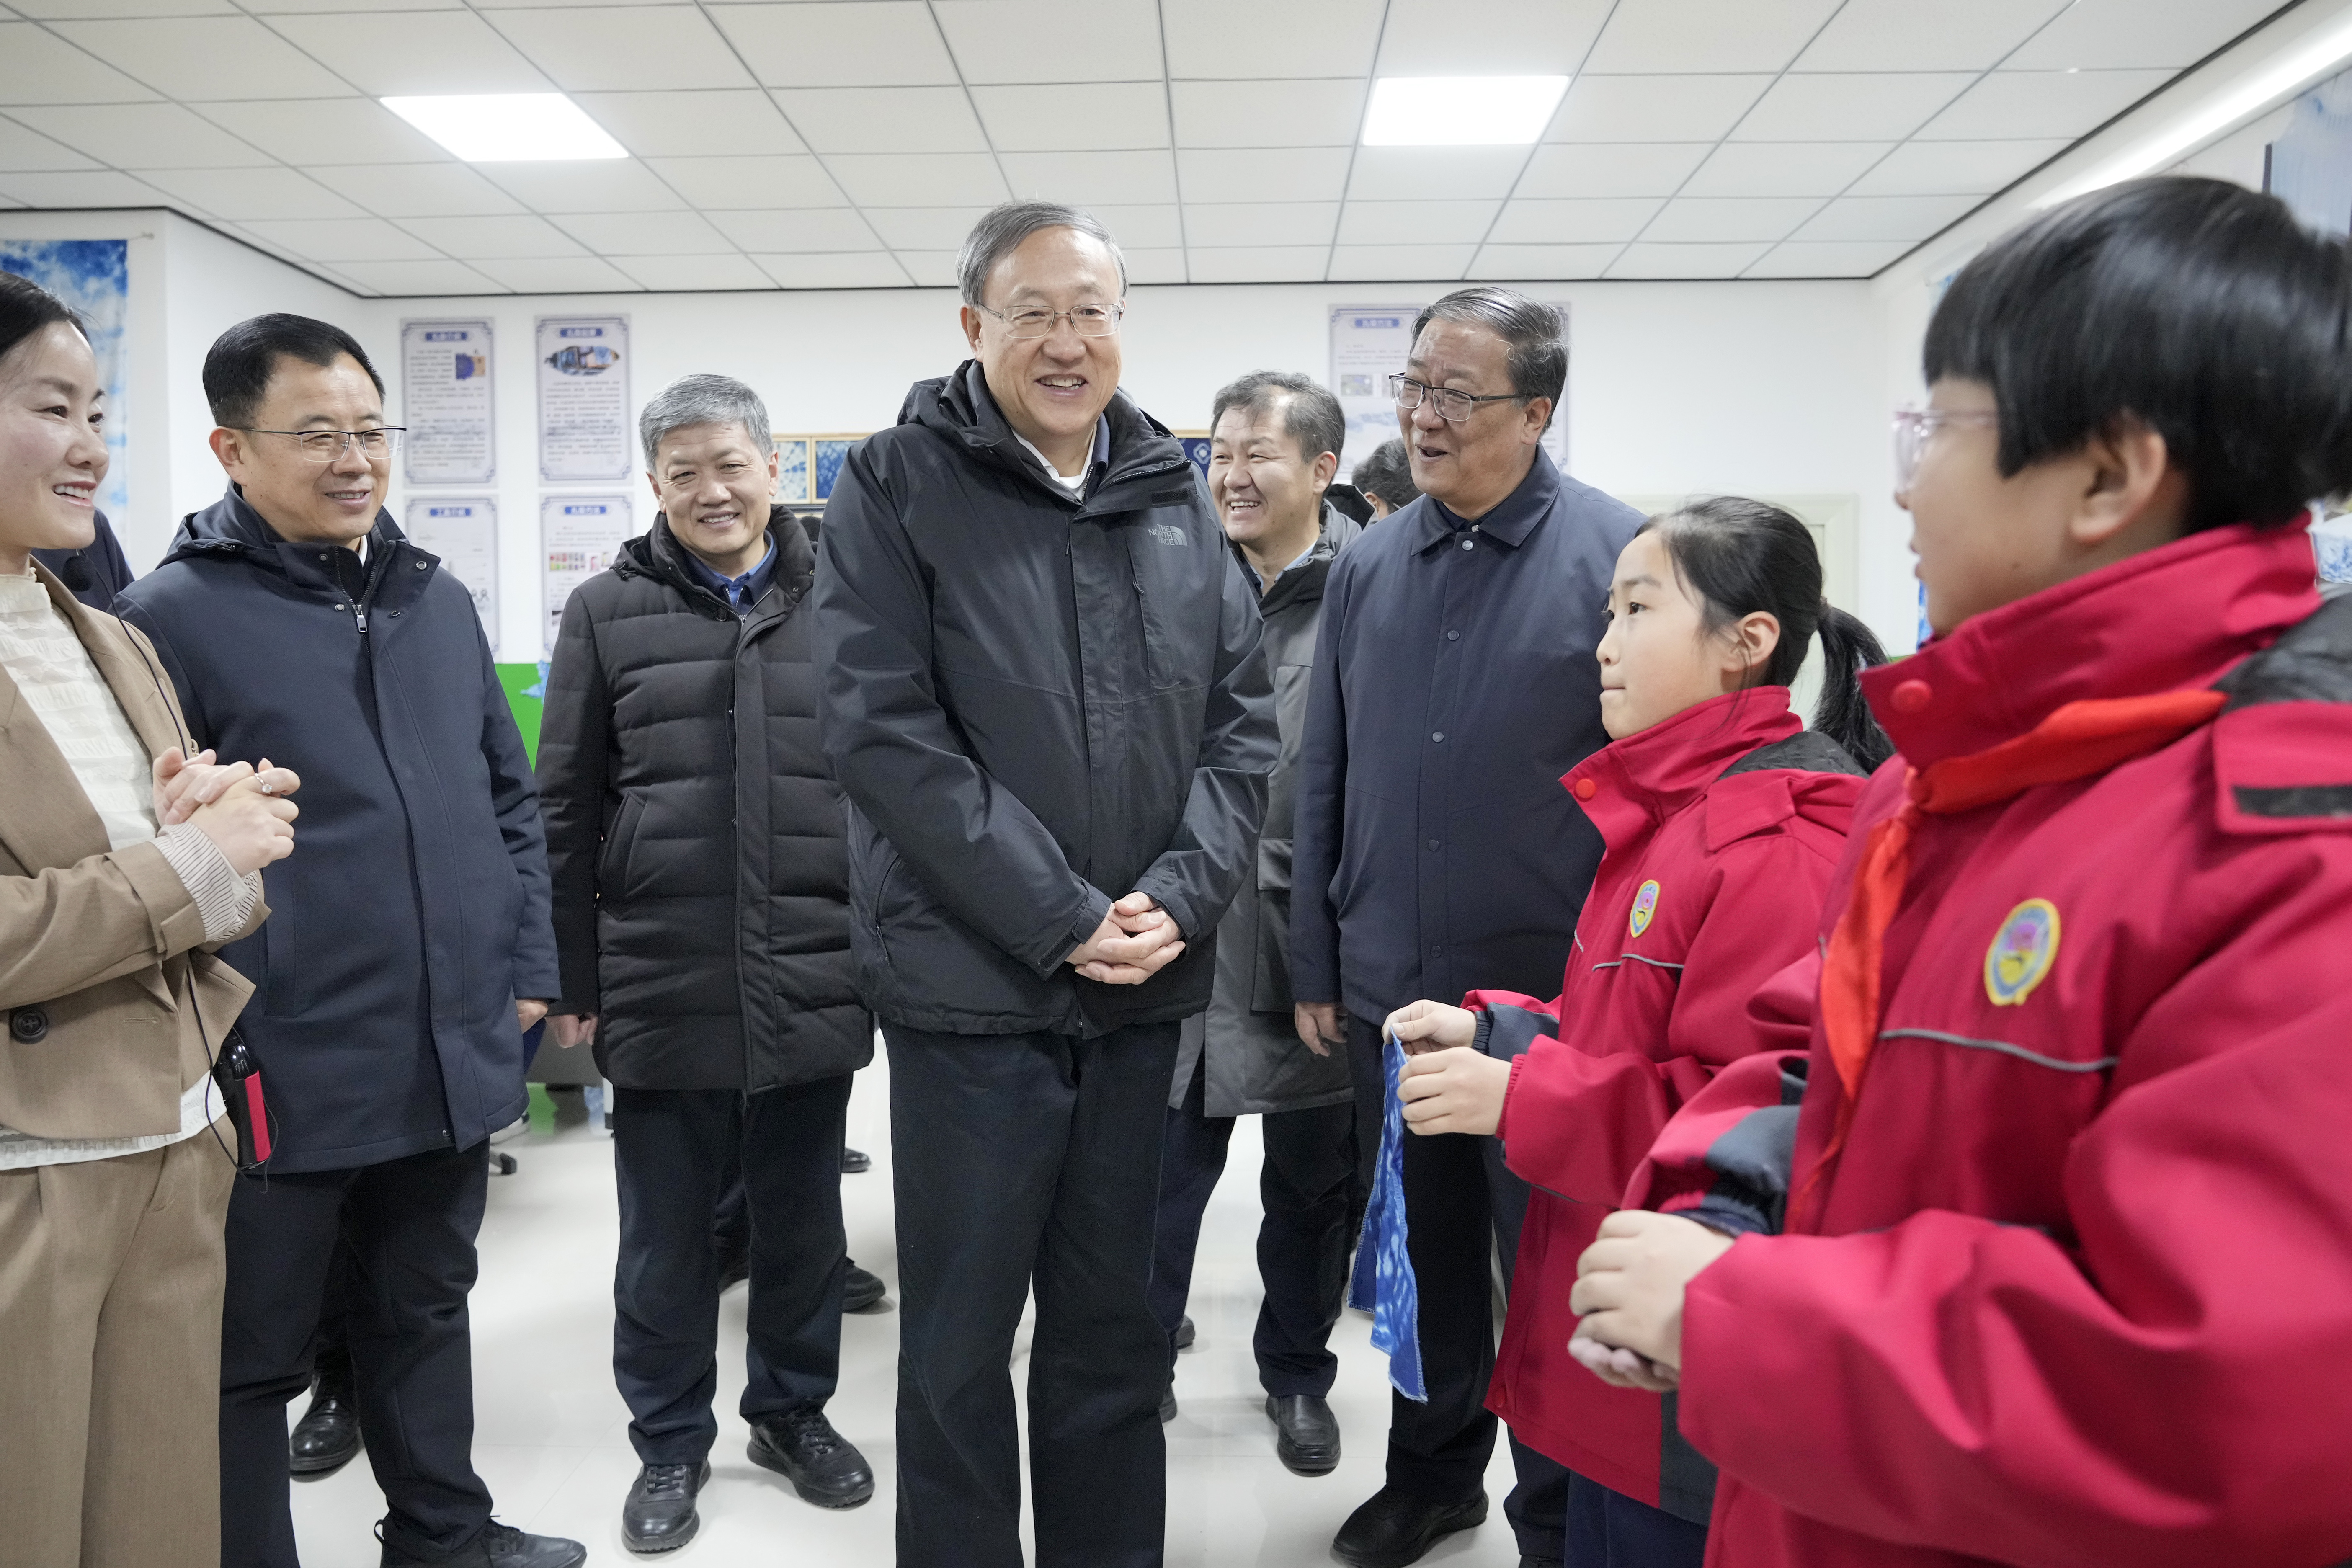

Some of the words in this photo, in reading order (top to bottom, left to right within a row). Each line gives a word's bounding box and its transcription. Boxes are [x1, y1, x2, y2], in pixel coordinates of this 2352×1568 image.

[1157, 524, 1171, 533] THE
[1148, 529, 1173, 539] NORTH
[1158, 536, 1175, 545] FACE
